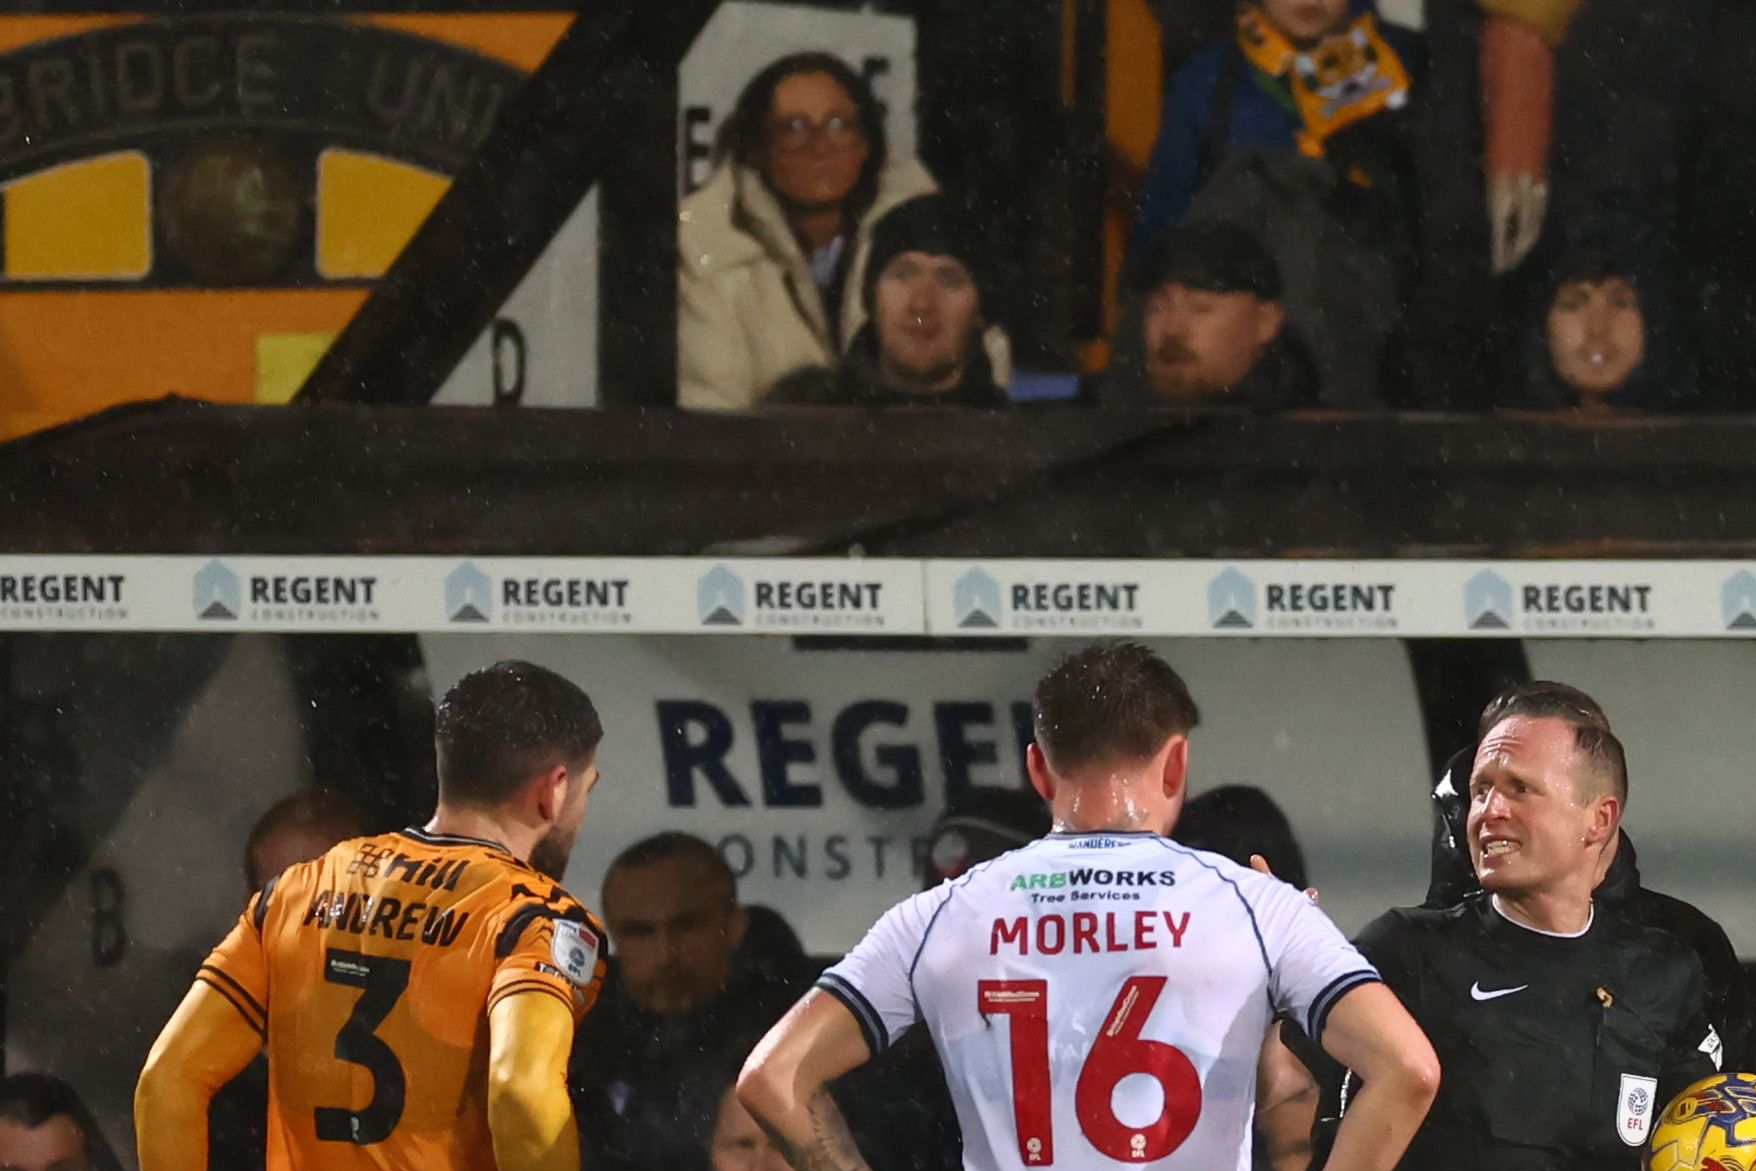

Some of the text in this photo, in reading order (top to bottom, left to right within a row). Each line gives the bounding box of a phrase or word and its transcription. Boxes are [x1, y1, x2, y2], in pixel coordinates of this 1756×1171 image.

[0, 576, 124, 602] REGENT
[251, 577, 375, 604] REGENT
[504, 580, 627, 606] REGENT
[756, 583, 881, 609] REGENT
[1013, 585, 1137, 610] REGENT
[1268, 585, 1393, 611] REGENT
[1524, 586, 1650, 612] REGENT
[1009, 867, 1176, 891] ARBWORKS
[1031, 889, 1140, 904] Tree Services
[303, 889, 470, 948] ANDREW
[990, 911, 1191, 956] MORLEY
[314, 947, 411, 1145] 3
[978, 975, 1202, 1167] 16
[1627, 1117, 1645, 1131] EFL
